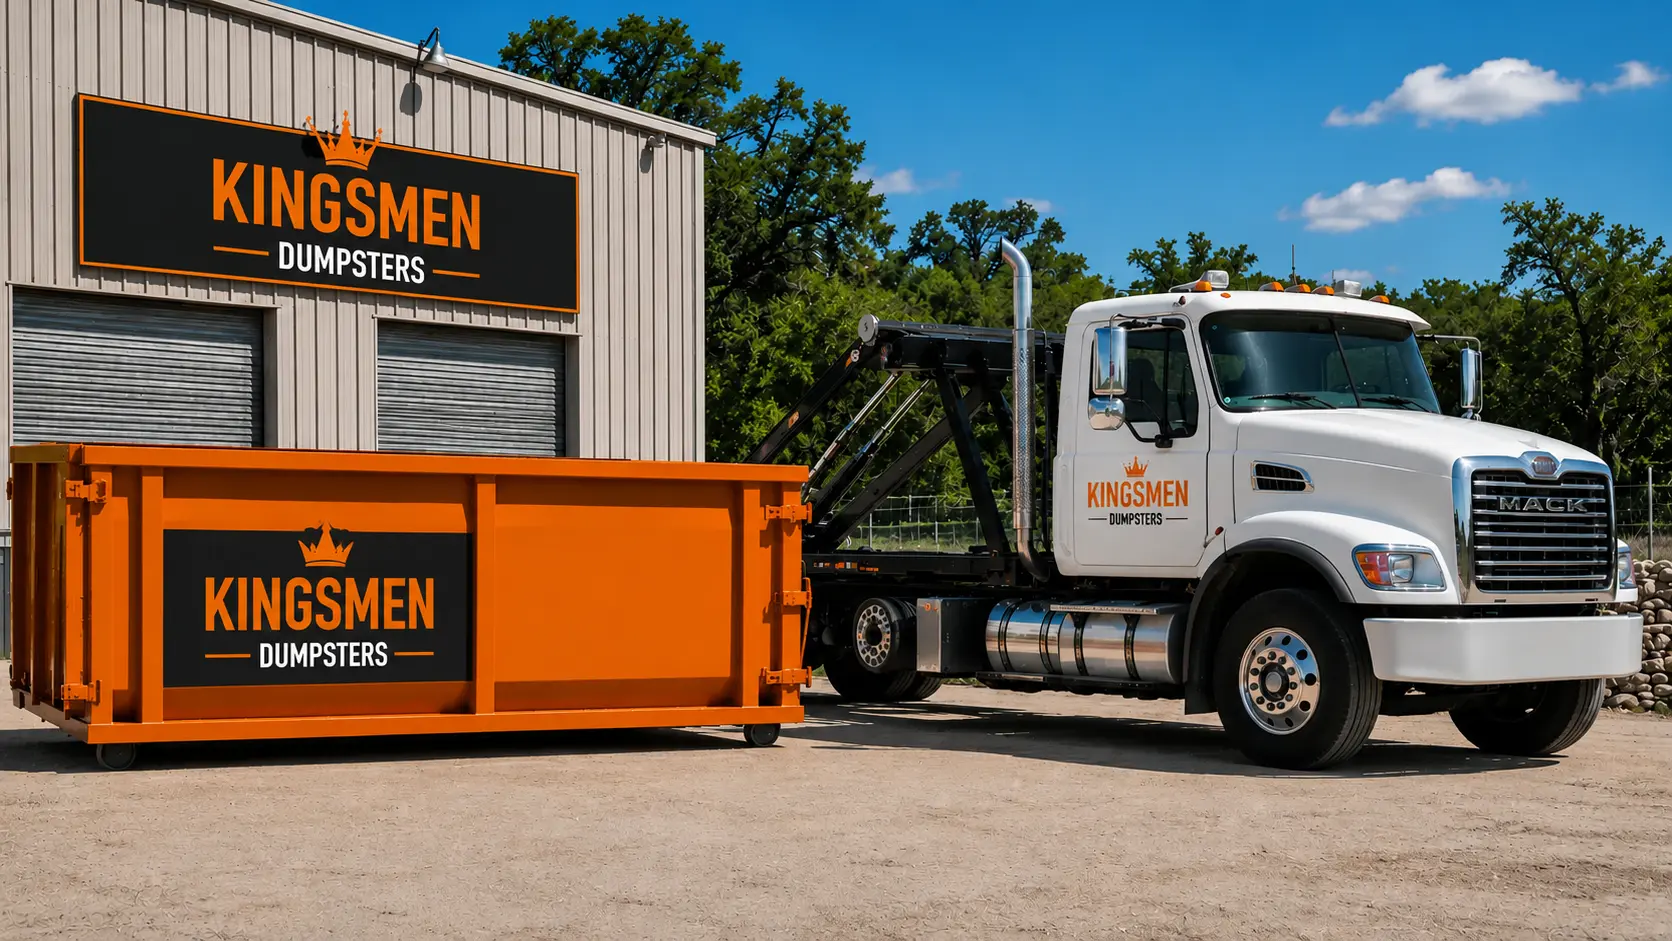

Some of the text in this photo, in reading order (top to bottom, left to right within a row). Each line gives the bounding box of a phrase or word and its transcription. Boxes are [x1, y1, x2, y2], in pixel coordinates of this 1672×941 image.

[213, 158, 481, 251] KINGSMEN
[278, 241, 425, 284] DUMPSTERS
[1088, 480, 1188, 508] KINGSMEN
[1499, 497, 1588, 512] MACK
[1109, 512, 1163, 525] DUMPSTERS
[205, 577, 434, 631] KINGSMEN
[259, 642, 388, 668] DUMPSTERS
